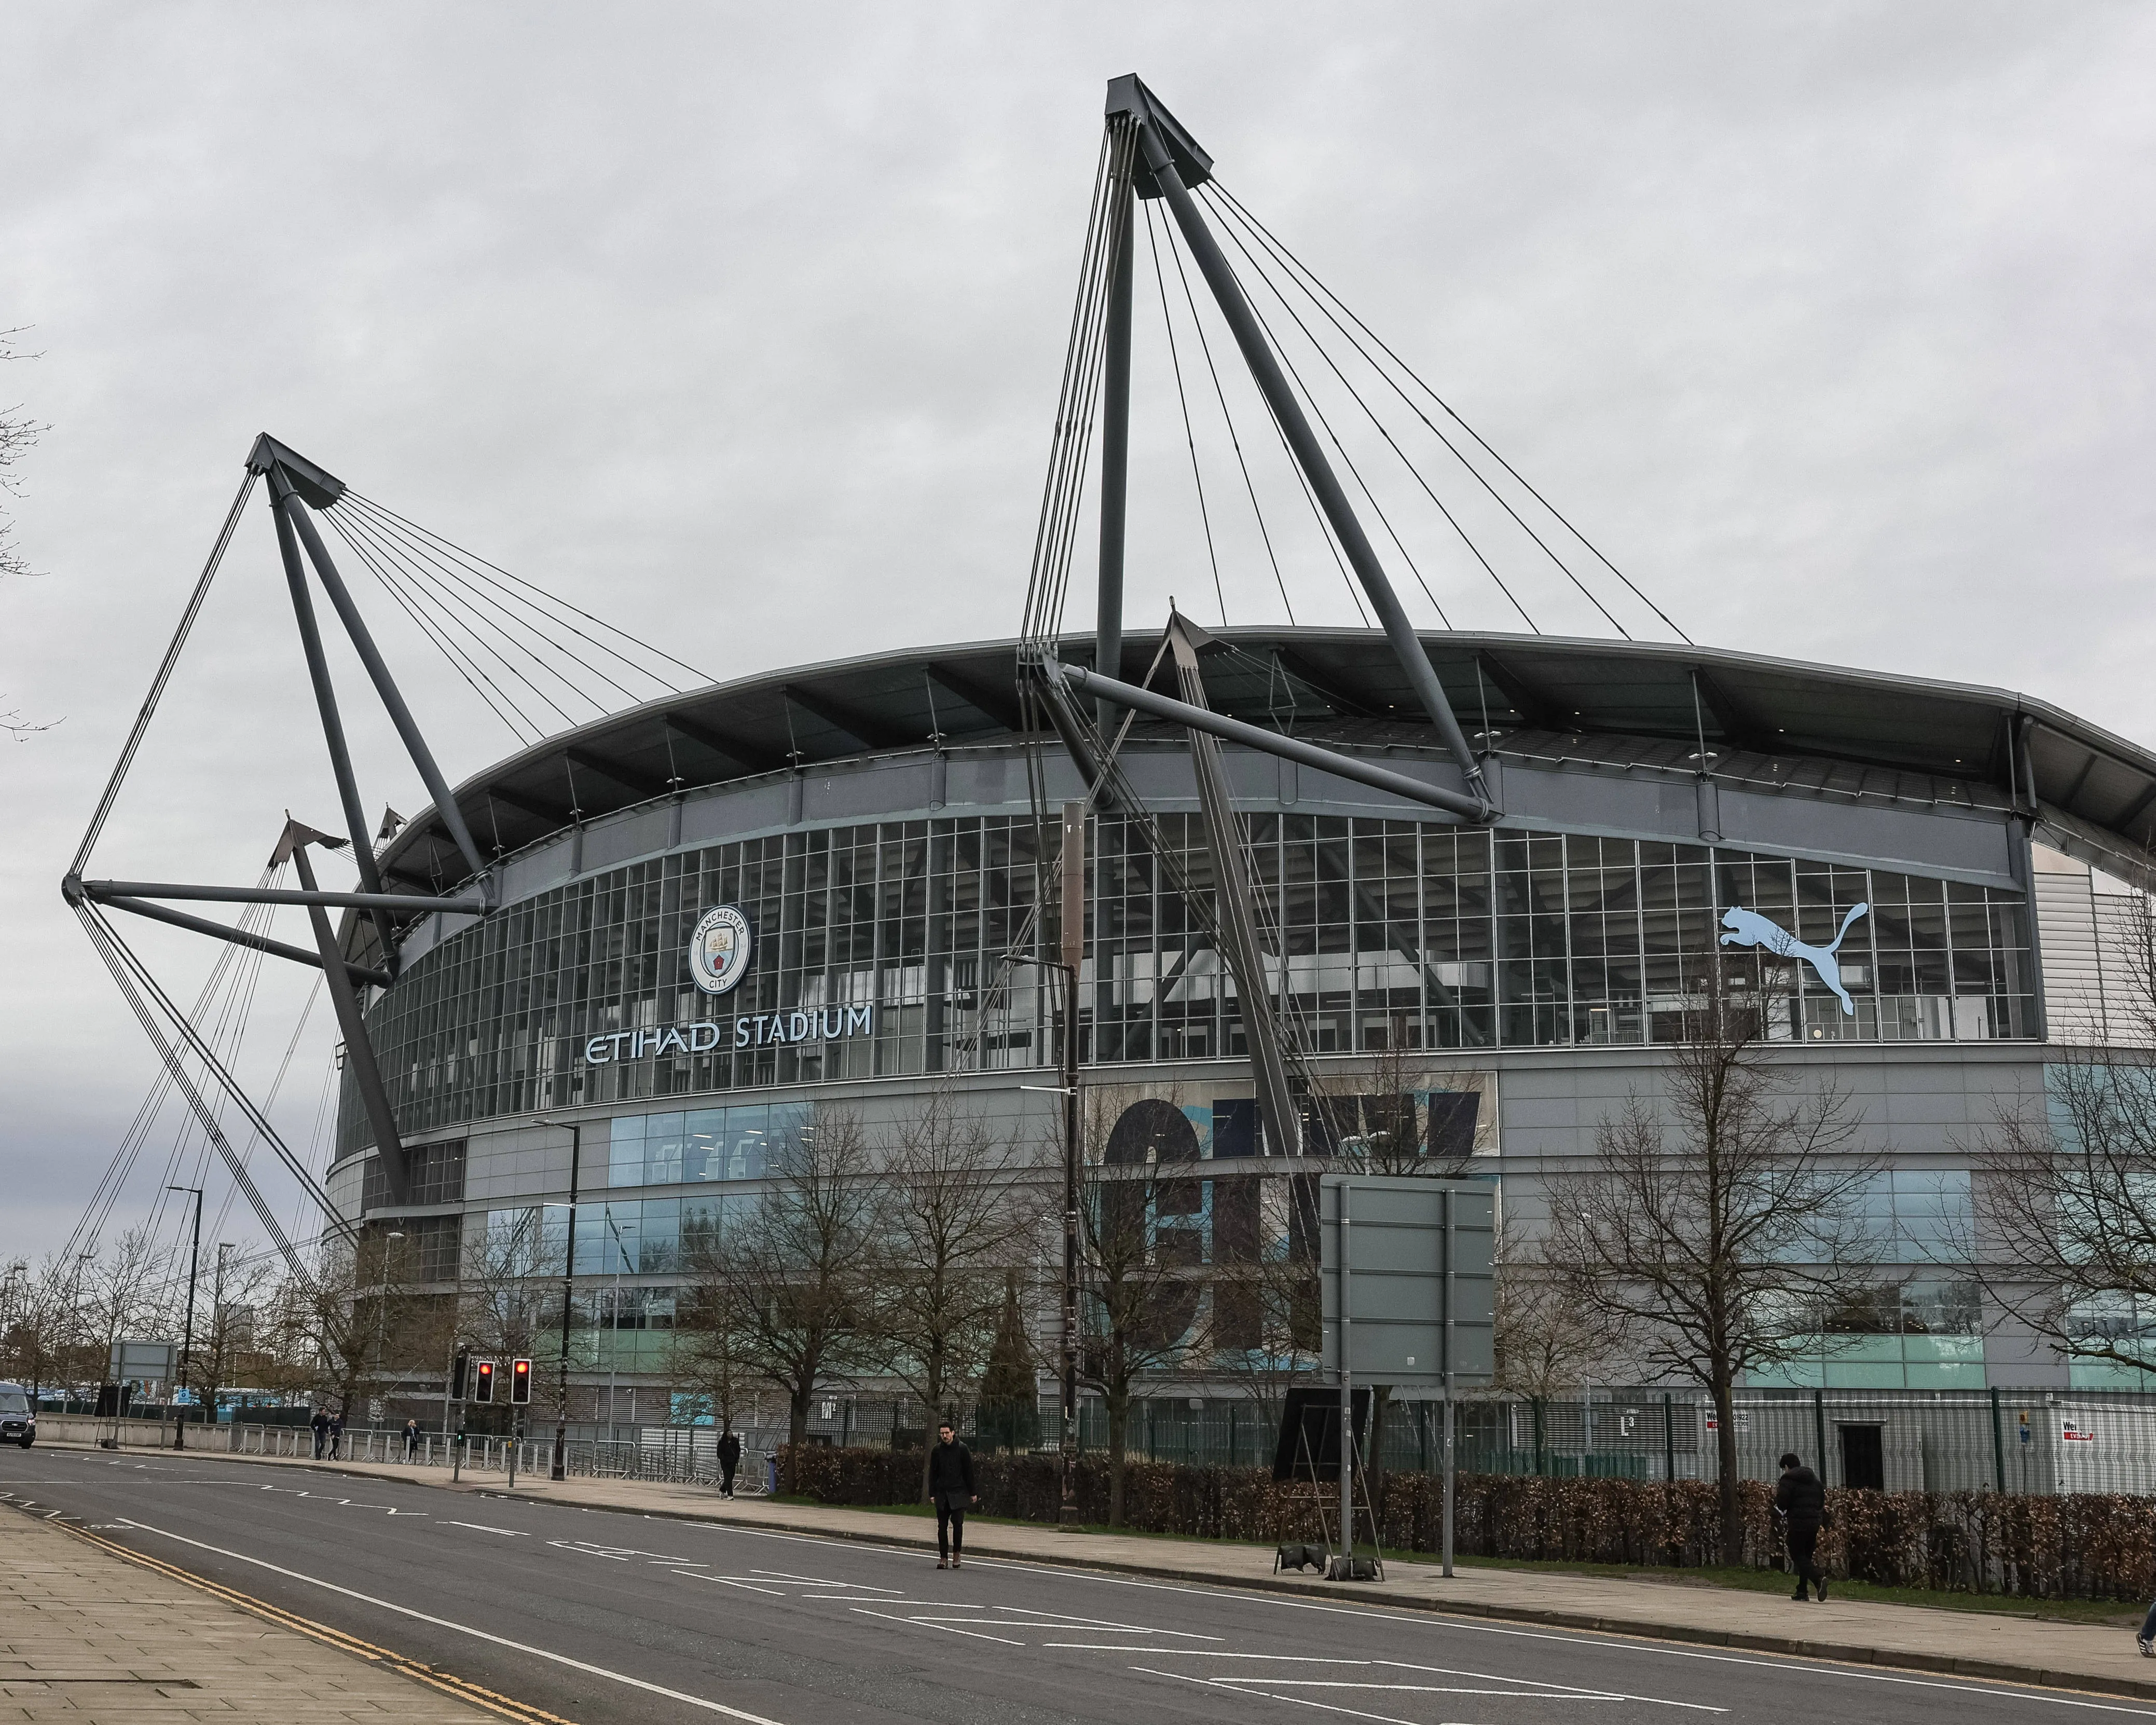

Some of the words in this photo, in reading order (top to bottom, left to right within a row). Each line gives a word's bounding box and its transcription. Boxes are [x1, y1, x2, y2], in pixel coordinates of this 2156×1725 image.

[696, 911, 745, 941] MANCHESTER
[709, 978, 727, 989] CITY
[586, 1022, 721, 1064] ETIHAD
[735, 1005, 873, 1048] STADIUM
